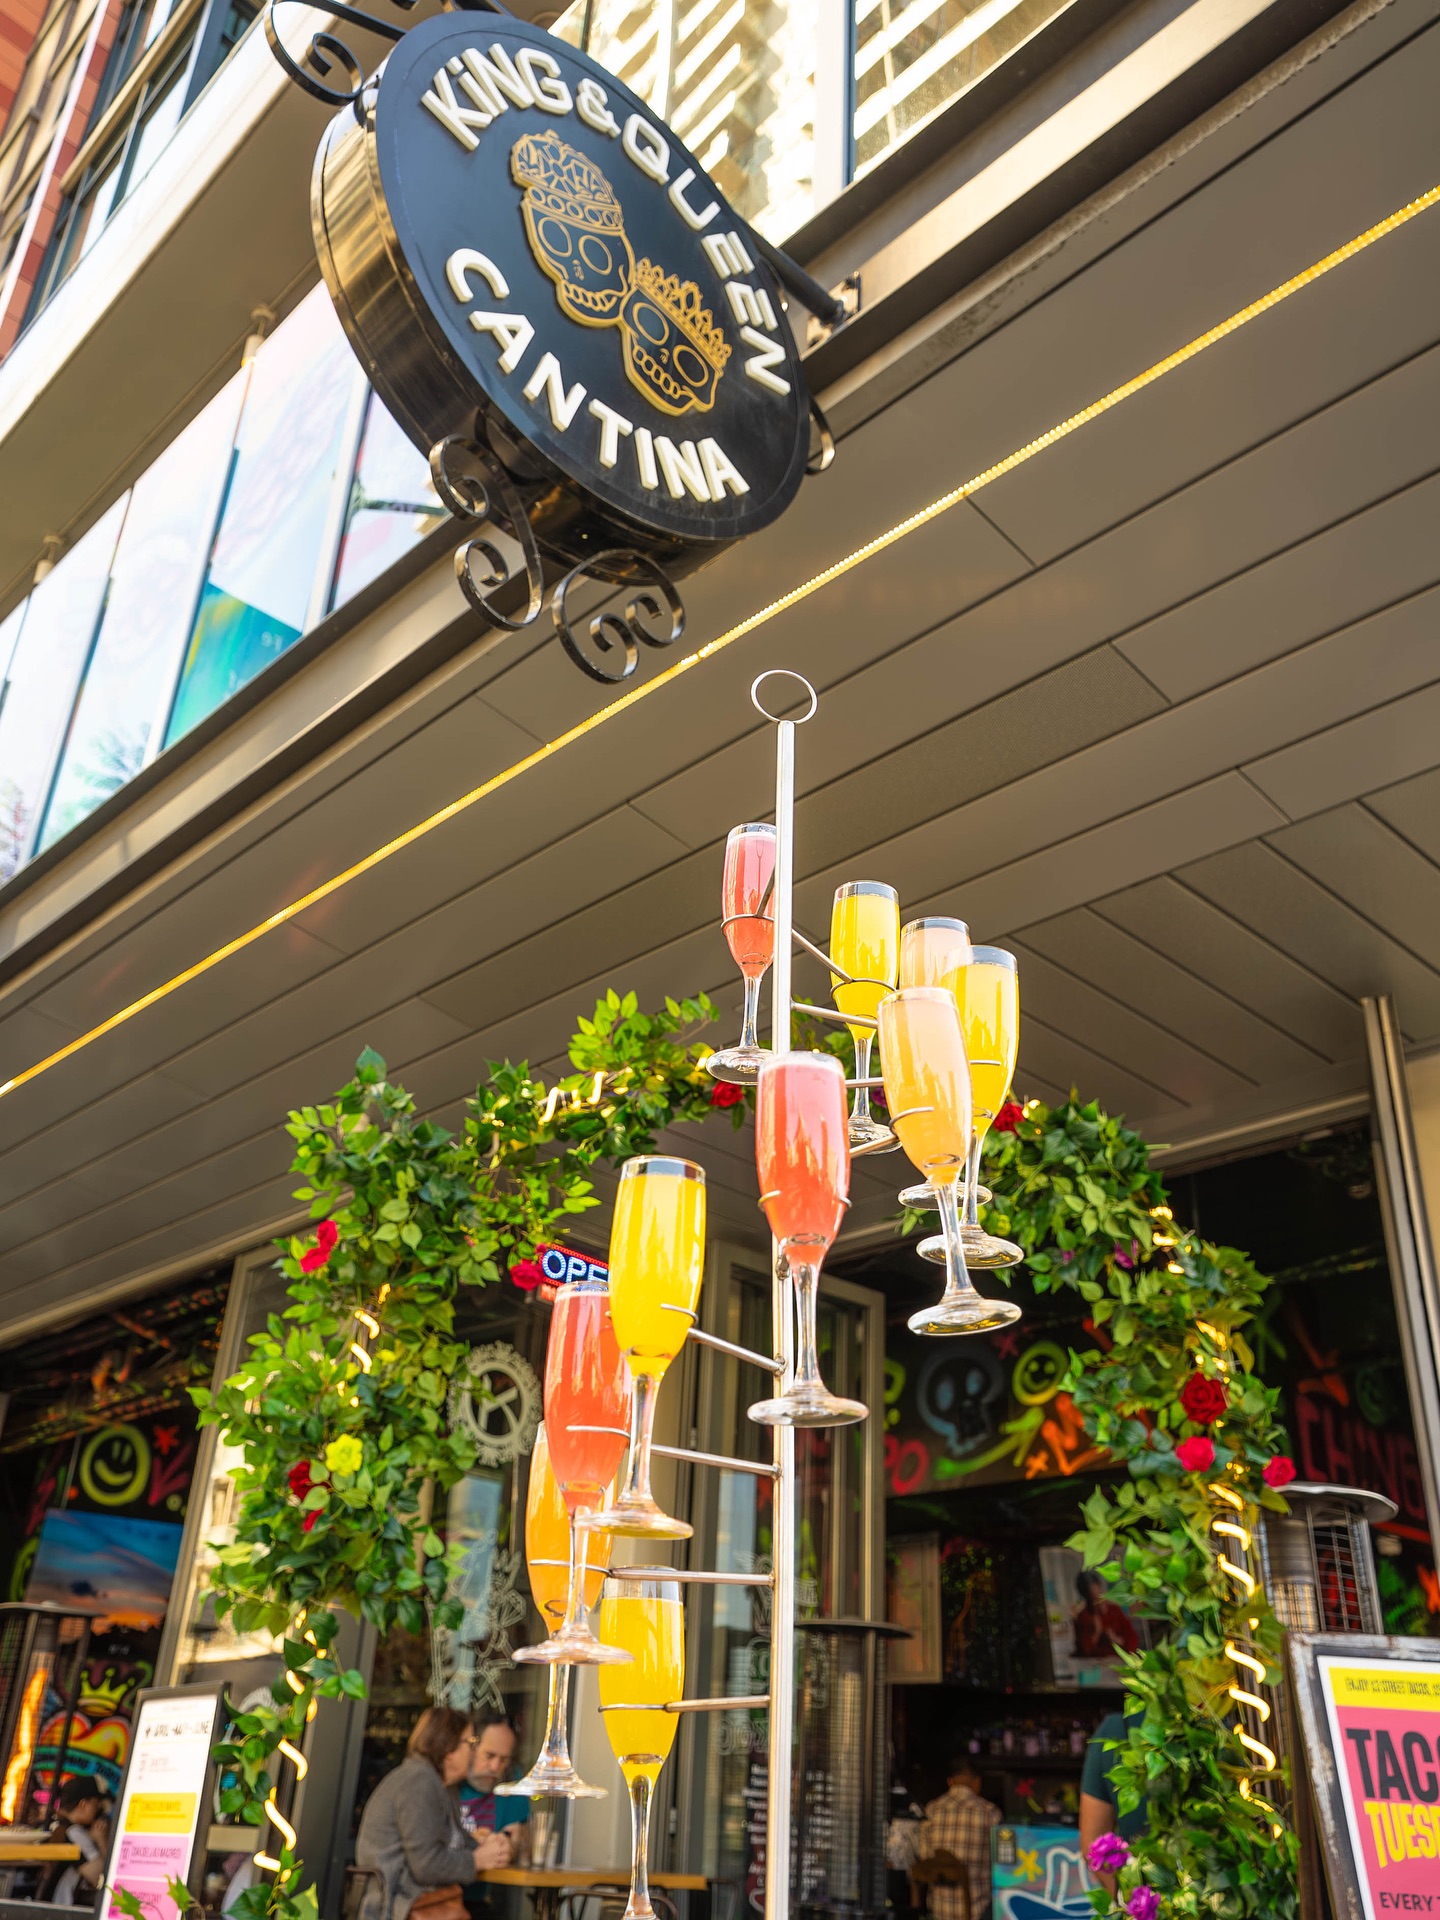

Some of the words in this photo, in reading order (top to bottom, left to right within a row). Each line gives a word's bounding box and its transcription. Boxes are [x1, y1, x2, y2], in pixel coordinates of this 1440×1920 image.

[446, 248, 750, 502] CANTINA
[542, 1250, 611, 1283] OPE
[1346, 1728, 1440, 1803] TAC
[1379, 1891, 1433, 1912] EVERY
